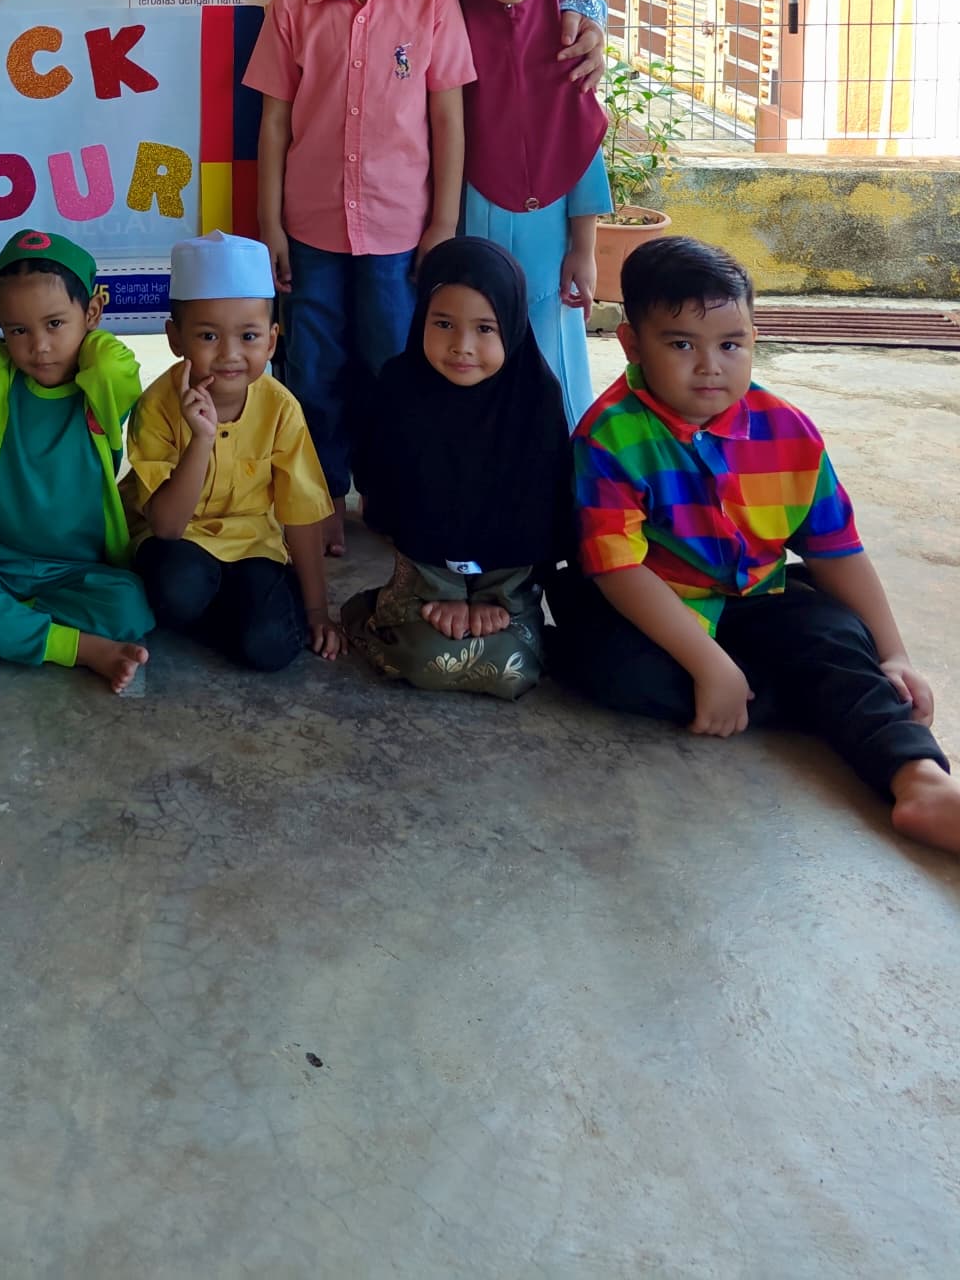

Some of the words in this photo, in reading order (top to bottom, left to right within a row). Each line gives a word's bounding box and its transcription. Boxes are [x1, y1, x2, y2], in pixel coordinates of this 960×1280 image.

[115, 282, 149, 294] Selamat
[151, 282, 169, 294] Hari
[115, 294, 137, 305] Guru
[138, 294, 160, 305] 2026
